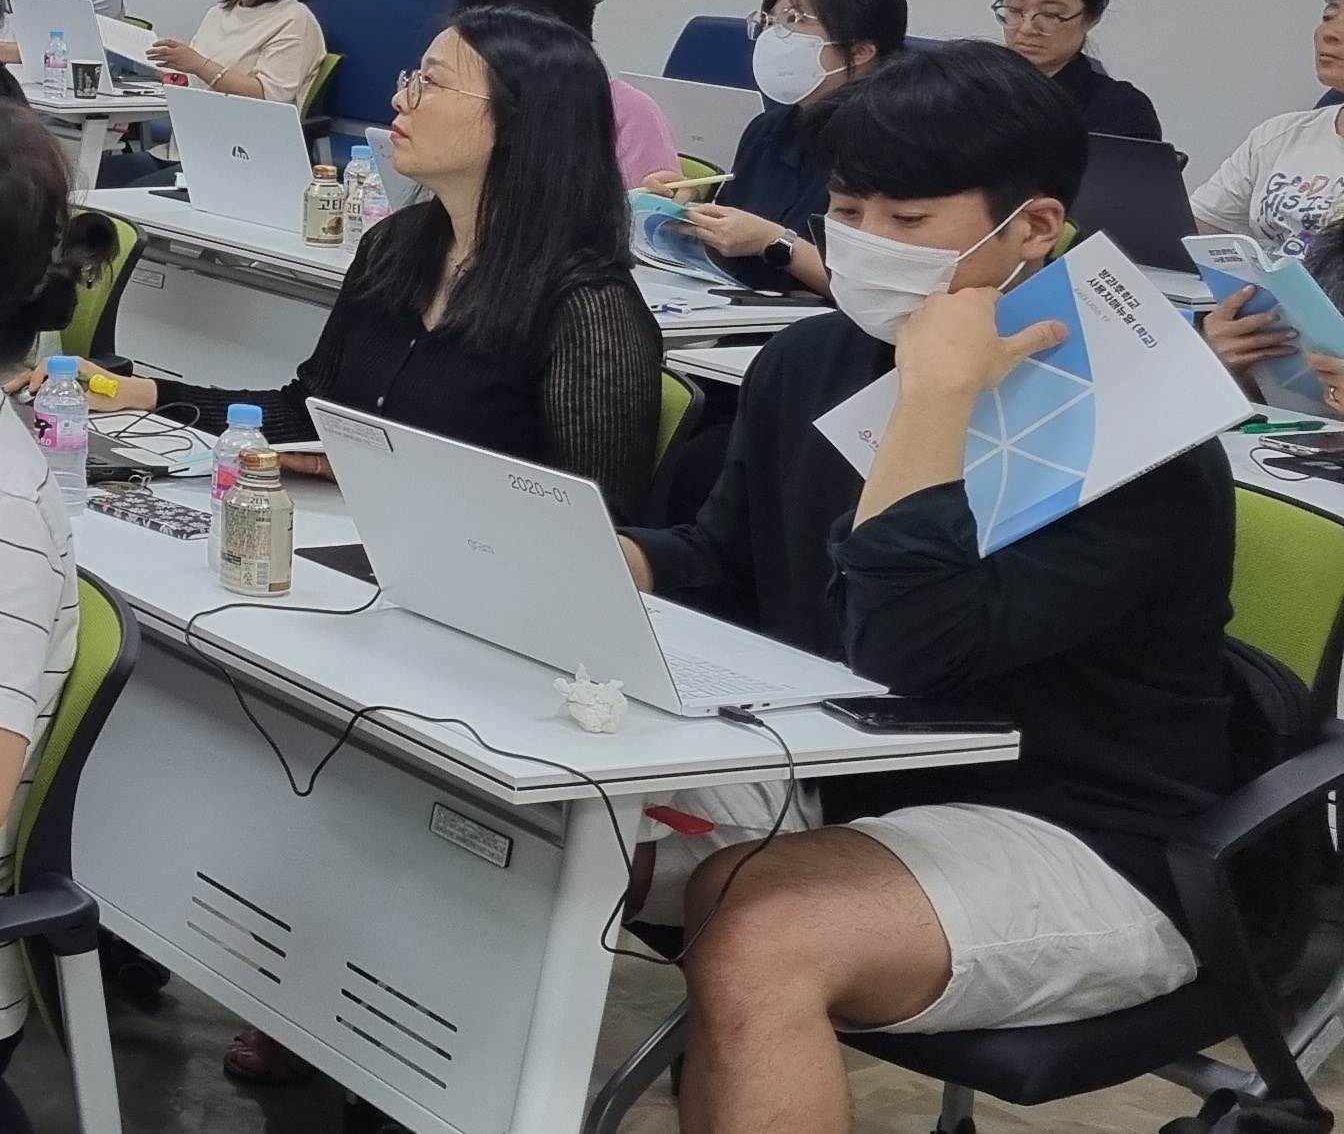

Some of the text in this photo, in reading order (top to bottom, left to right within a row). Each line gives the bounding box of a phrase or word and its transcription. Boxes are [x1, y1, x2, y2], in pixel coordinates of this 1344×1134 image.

[1097, 268, 1141, 311] 방과후학교
[1085, 277, 1158, 349] 사용자매뉴얼 (학교)
[508, 473, 572, 506] 2020-01
